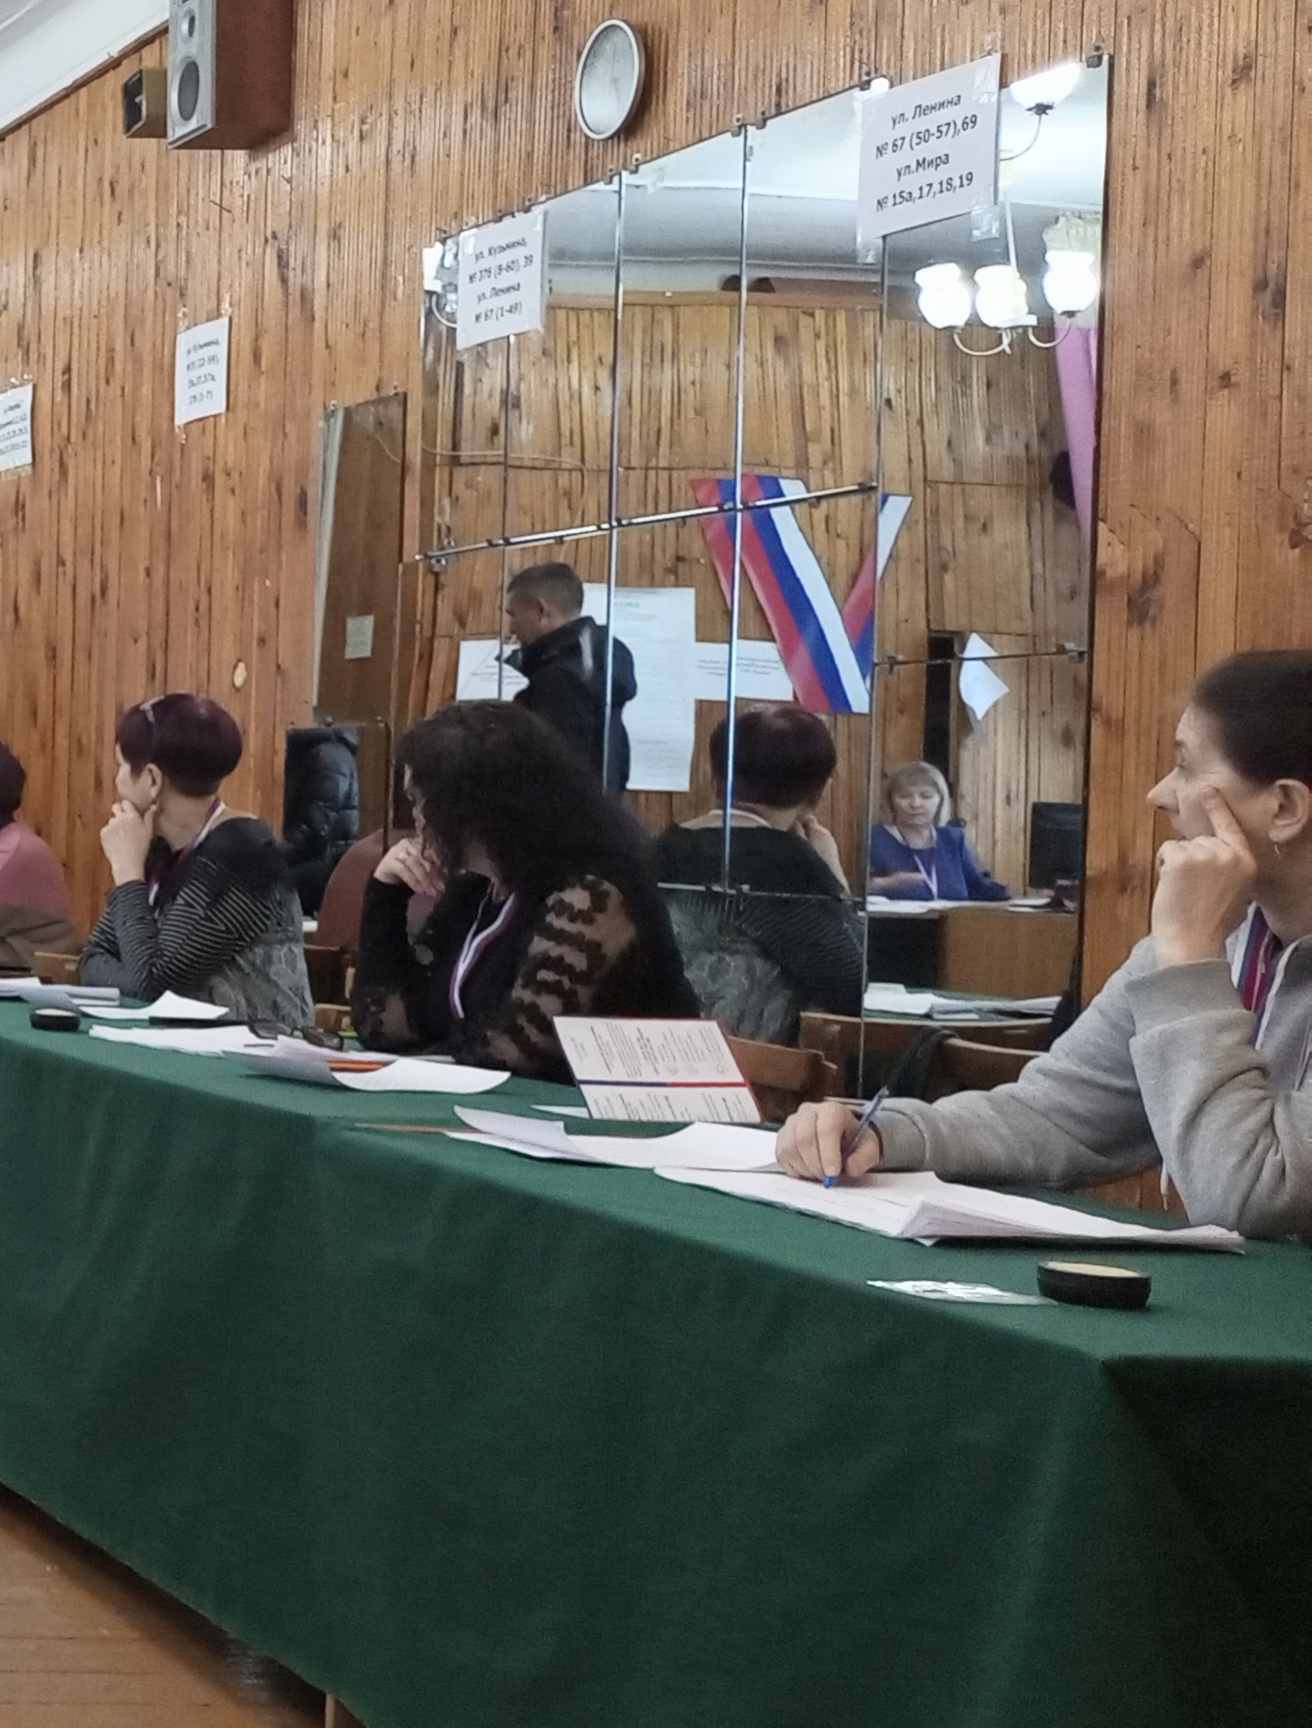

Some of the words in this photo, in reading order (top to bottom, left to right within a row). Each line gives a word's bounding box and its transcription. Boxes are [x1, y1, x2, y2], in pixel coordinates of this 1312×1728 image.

[891, 113, 909, 130] ул.
[912, 94, 962, 120] Ленина
[875, 142, 888, 160] №
[891, 136, 906, 154] 67
[876, 195, 889, 212] №
